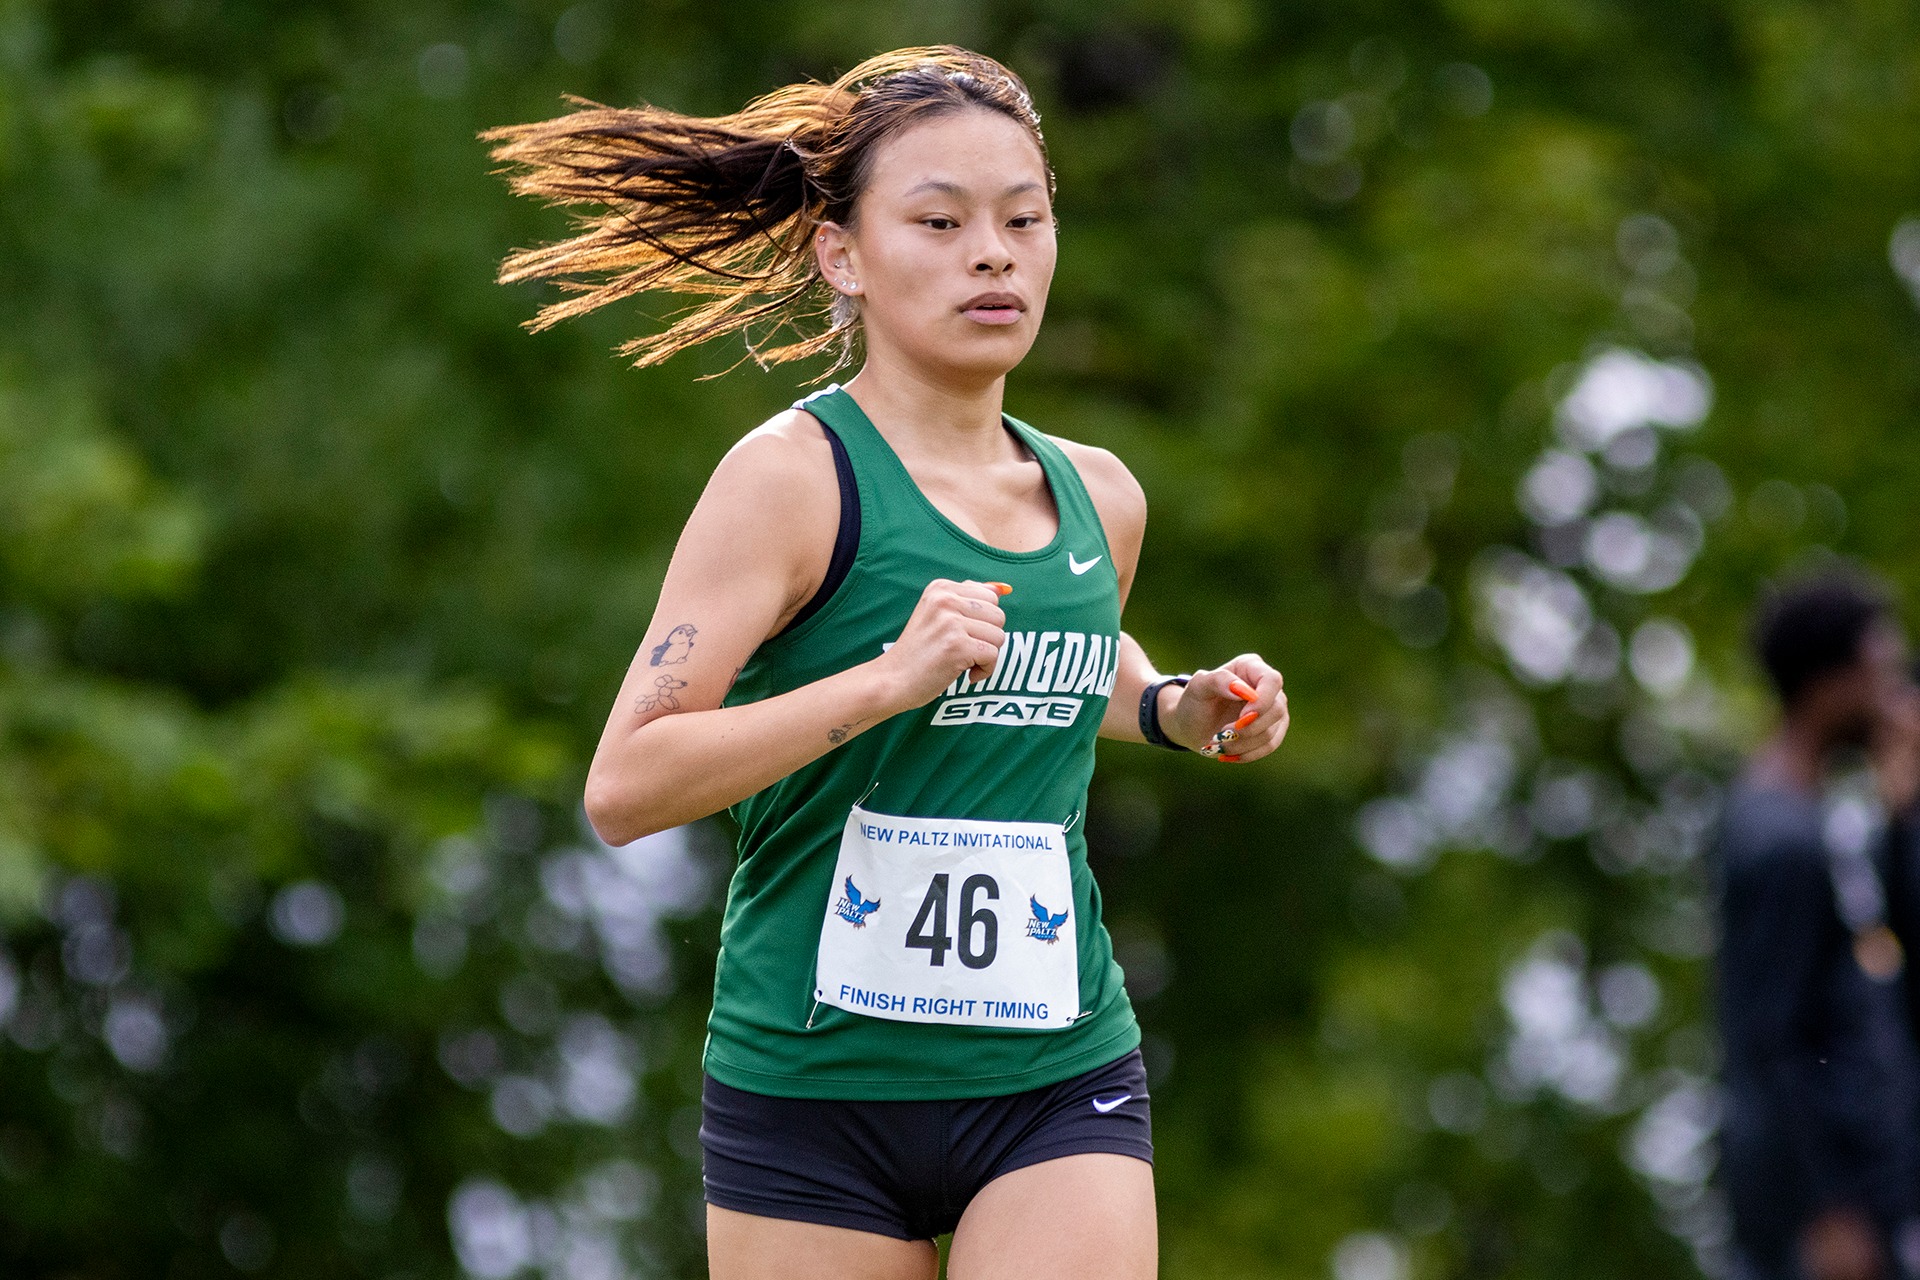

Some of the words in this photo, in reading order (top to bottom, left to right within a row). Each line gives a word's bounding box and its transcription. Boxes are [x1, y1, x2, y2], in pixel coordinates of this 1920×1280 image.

[882, 631, 1121, 698] INGDAL
[941, 700, 1076, 721] STATE
[860, 822, 894, 843] NEW
[898, 830, 949, 846] PALTZ
[953, 832, 1053, 850] INVITATIONAL
[837, 907, 865, 920] PALTZ
[838, 898, 860, 912] NEW
[904, 873, 1000, 970] 46
[1028, 918, 1050, 928] NEW
[1029, 927, 1056, 936] PALTZ
[839, 984, 906, 1012] FINISH
[912, 997, 977, 1016] RIGHT
[982, 1000, 1049, 1020] TIMING
